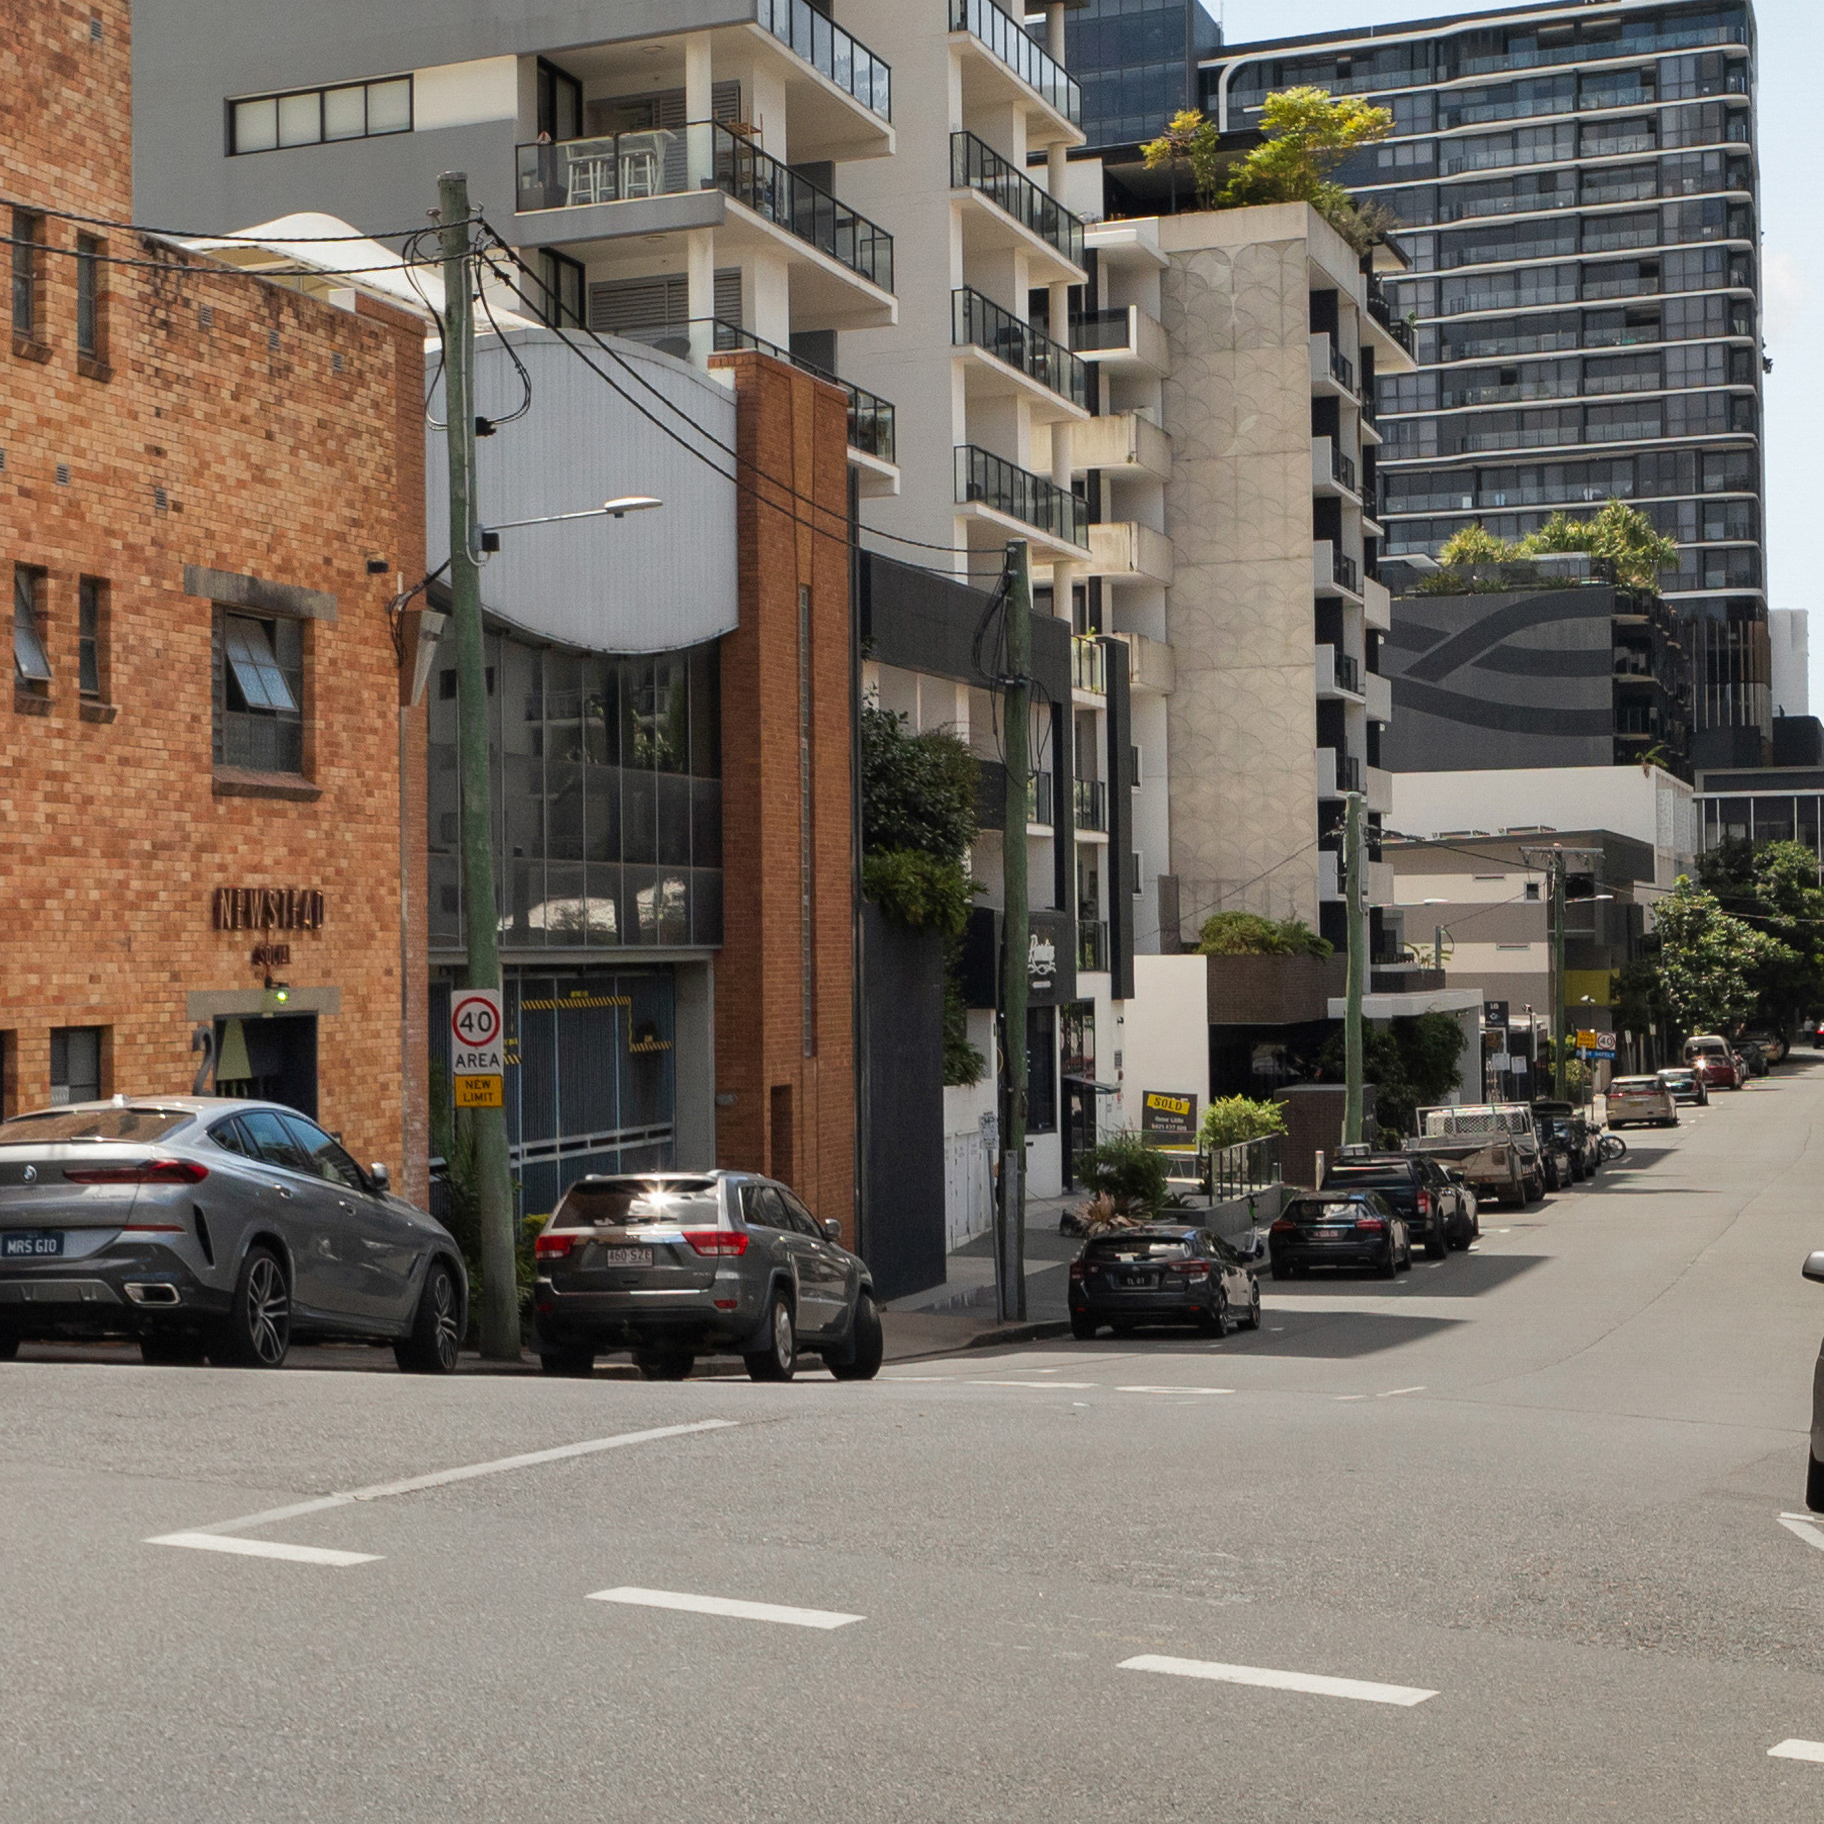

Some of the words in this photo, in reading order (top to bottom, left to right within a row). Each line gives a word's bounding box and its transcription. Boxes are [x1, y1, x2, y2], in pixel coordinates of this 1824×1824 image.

[213, 888, 324, 928] NEWSTEAD
[459, 1011, 492, 1033] 40
[1600, 1037, 1613, 1046] 40
[455, 1053, 500, 1068] AREA
[464, 1079, 491, 1090] NEW
[463, 1092, 492, 1103] LIMIT
[1154, 1097, 1183, 1111] SOLD
[7, 1240, 33, 1254] MRS
